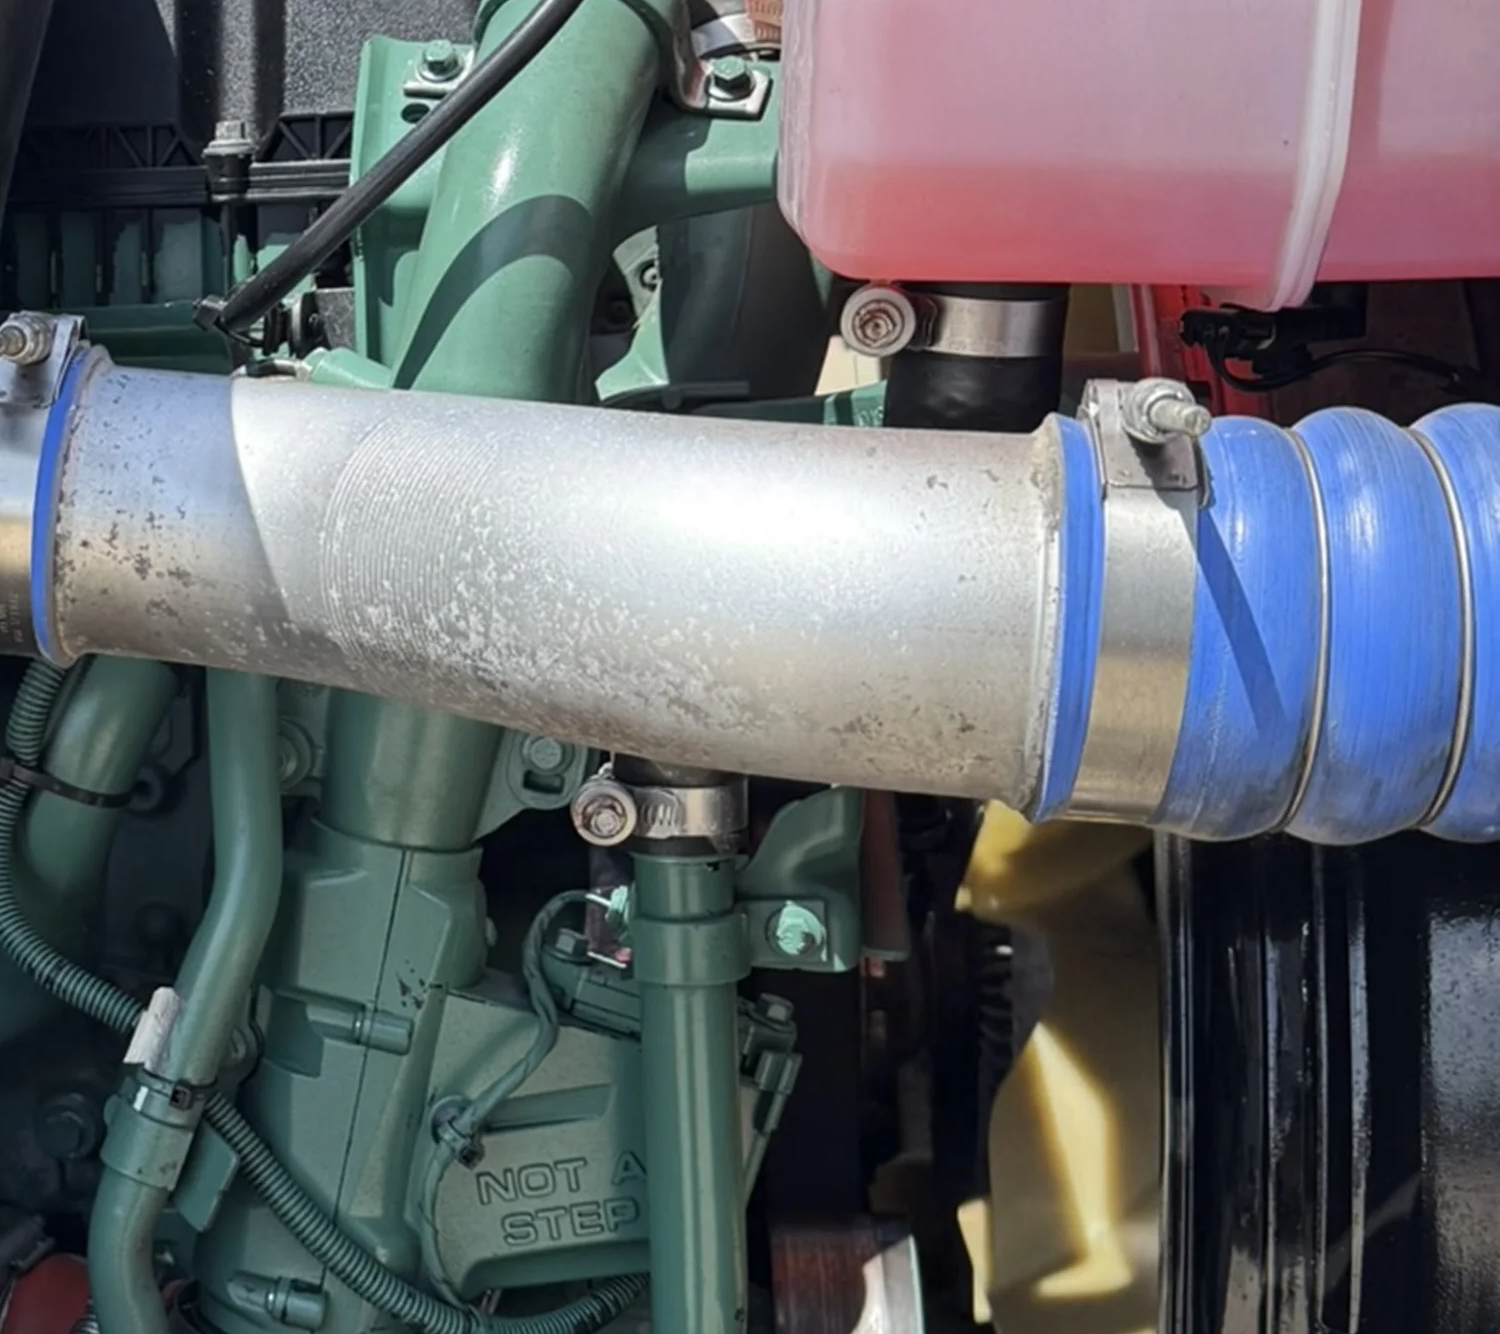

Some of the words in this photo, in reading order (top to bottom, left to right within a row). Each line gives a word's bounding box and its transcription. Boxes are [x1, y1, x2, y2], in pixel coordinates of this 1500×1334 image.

[476, 1156, 588, 1206] NOT
[611, 1150, 648, 1187] A
[502, 1196, 641, 1247] STEP
